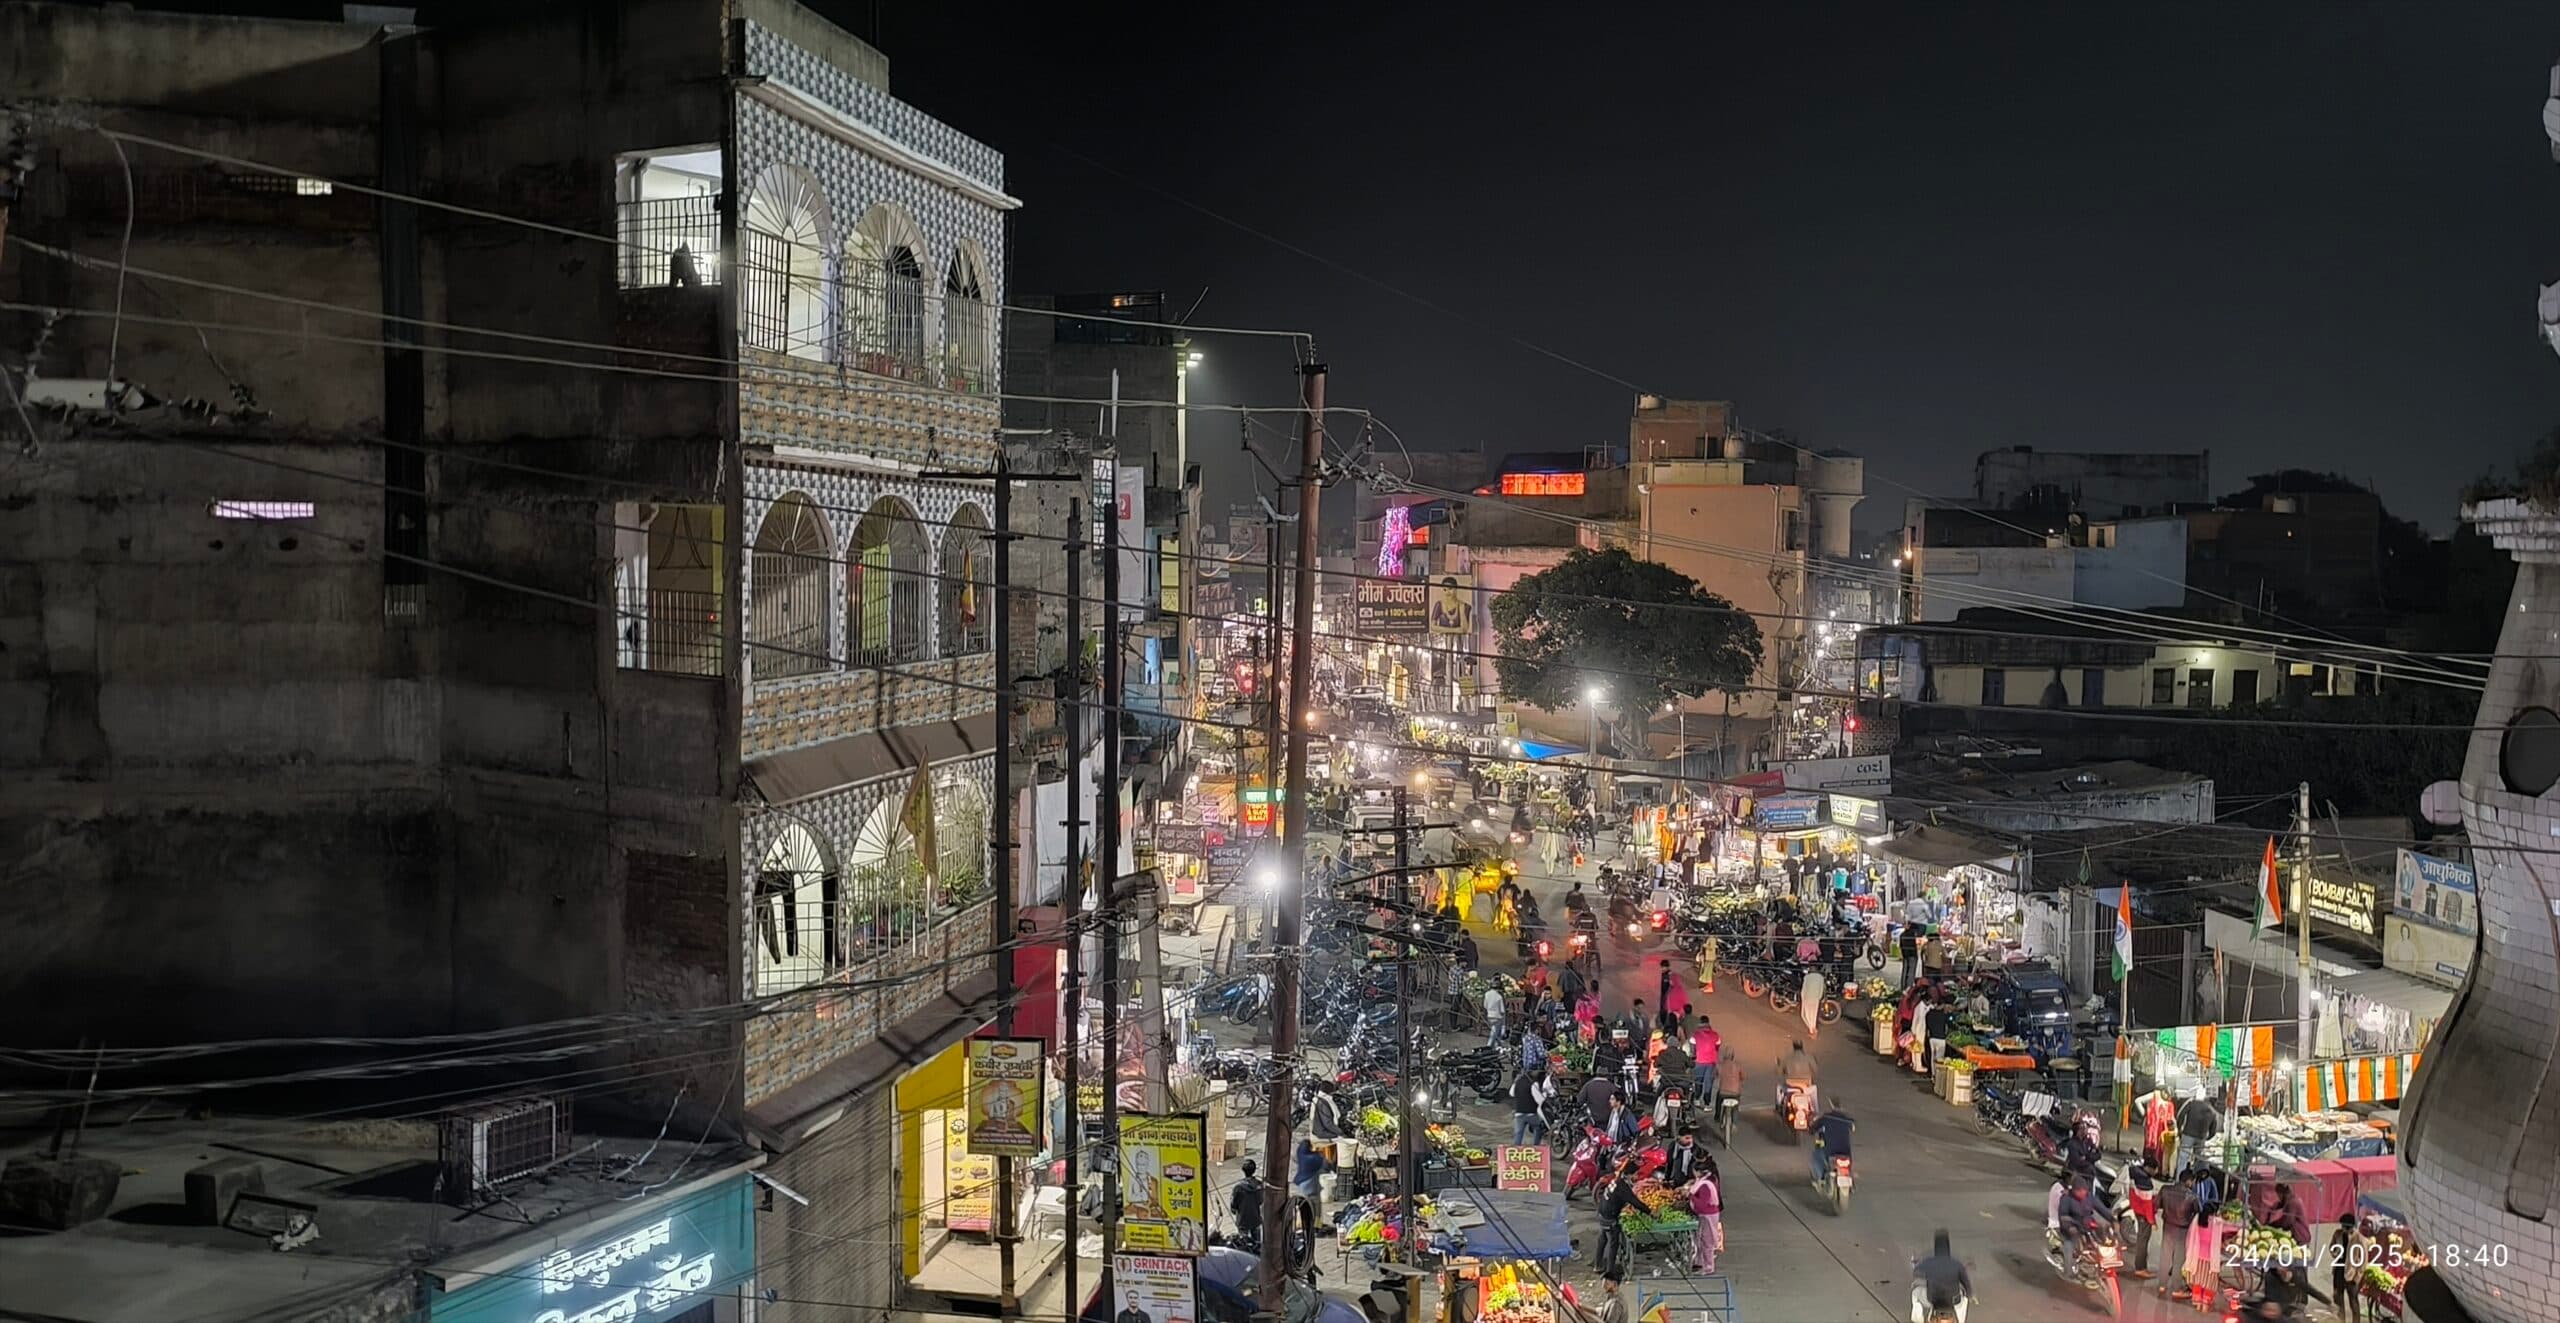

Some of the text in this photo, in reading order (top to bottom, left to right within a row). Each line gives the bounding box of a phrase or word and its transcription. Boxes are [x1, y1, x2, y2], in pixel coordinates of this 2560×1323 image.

[1358, 580, 1384, 603] भीम
[2421, 859, 2473, 885] आधुनिक
[2312, 878, 2346, 903] BOMBAY
[2345, 881, 2375, 911] SALON
[1505, 1147, 1543, 1163] सिद्धि
[1502, 1165, 1545, 1180] लेडीज
[1133, 1257, 1190, 1272] GRINTACK
